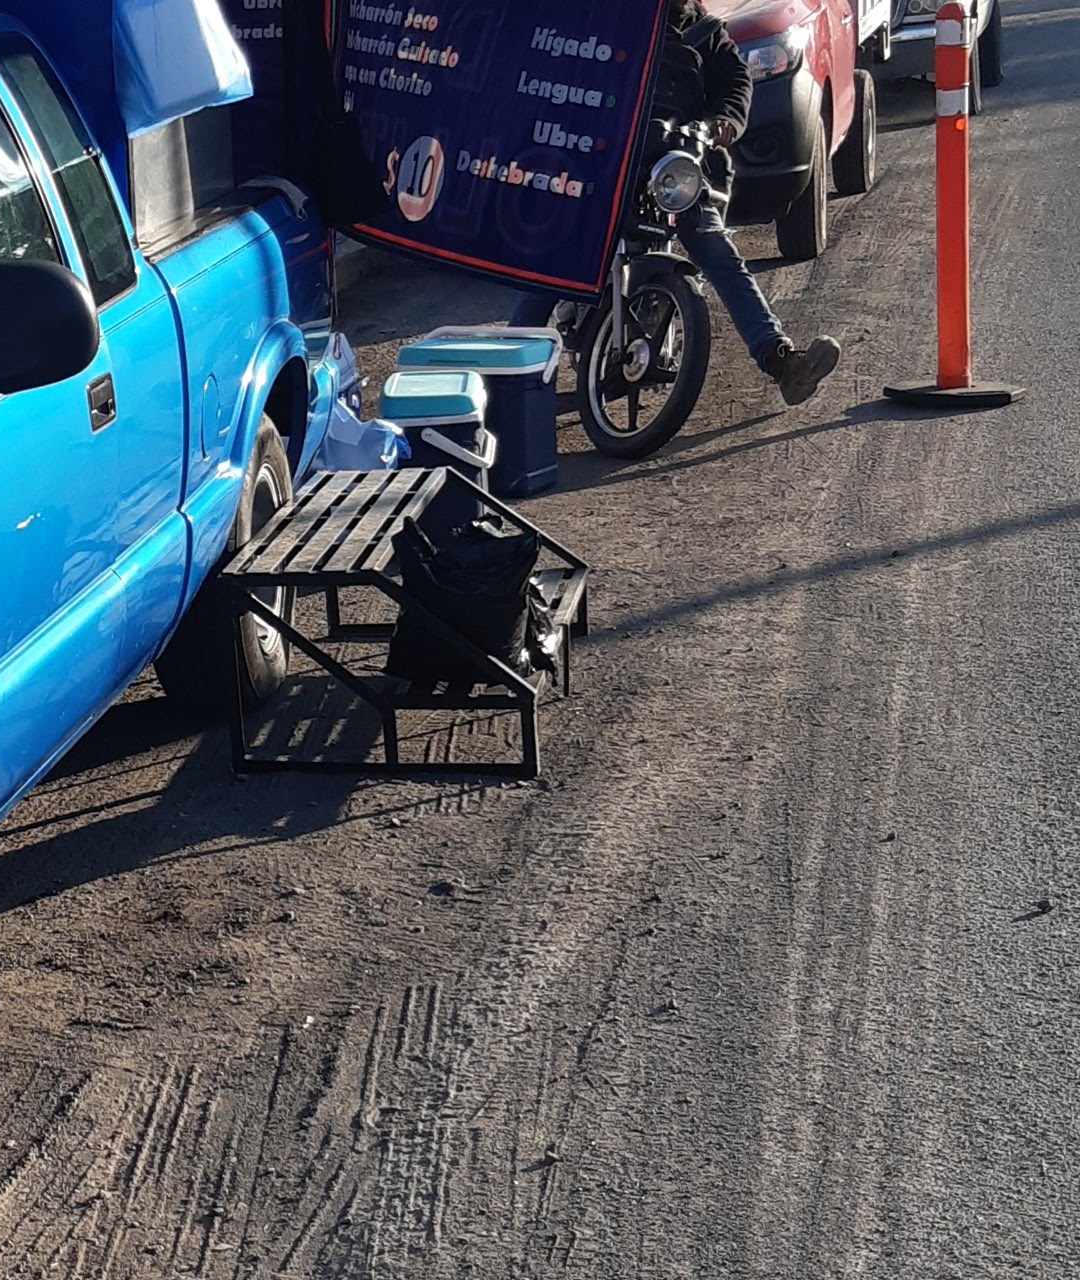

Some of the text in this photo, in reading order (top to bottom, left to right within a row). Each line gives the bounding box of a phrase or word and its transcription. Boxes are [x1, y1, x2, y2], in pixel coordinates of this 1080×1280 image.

[231, 23, 284, 40] brada
[404, 6, 439, 32] Seco
[396, 37, 460, 69] Guisado
[530, 26, 613, 62] Hígado
[358, 66, 378, 86] con
[378, 66, 433, 97] Chorizo
[516, 71, 604, 108] Lengua
[532, 120, 594, 153] Ubre
[456, 149, 585, 198] Deshebrada
